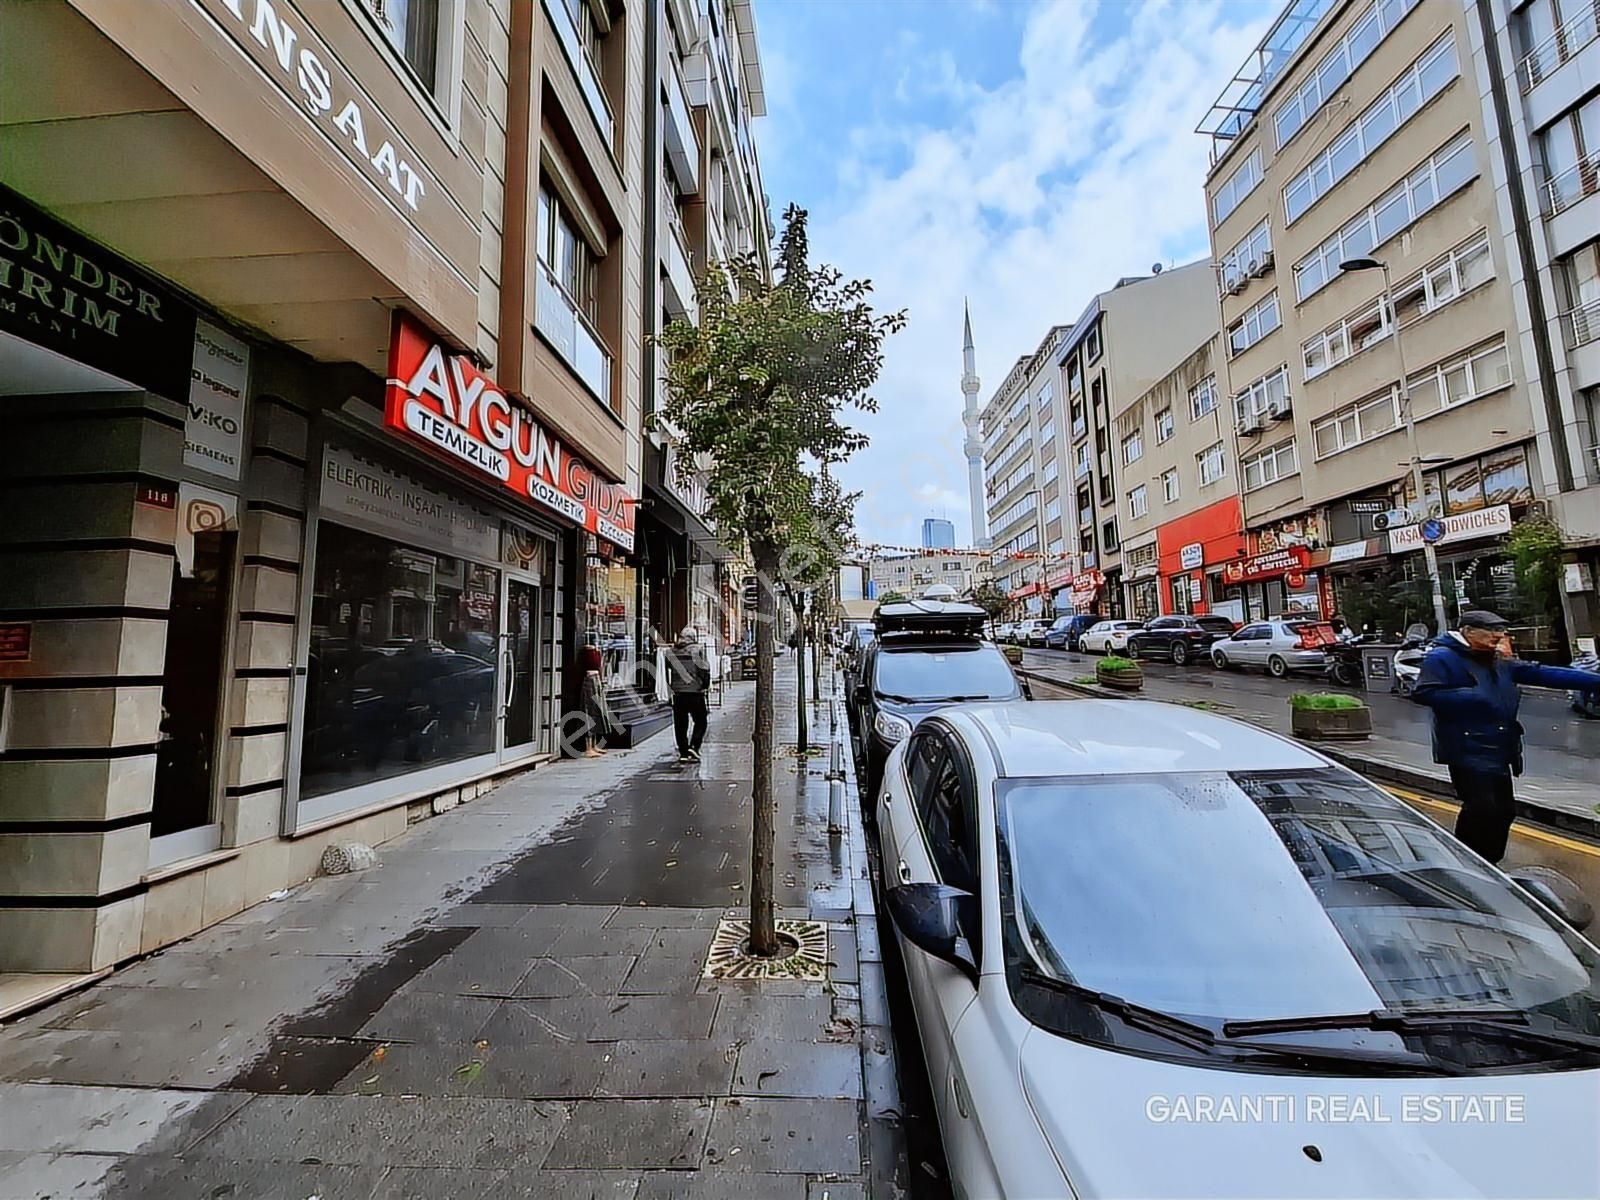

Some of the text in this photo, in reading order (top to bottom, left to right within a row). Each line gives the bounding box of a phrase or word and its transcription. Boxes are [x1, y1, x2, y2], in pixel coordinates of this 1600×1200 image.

[407, 344, 633, 534] AYGÜN GIDA
[184, 440, 235, 465] SIEMENS
[148, 489, 168, 502] 118
